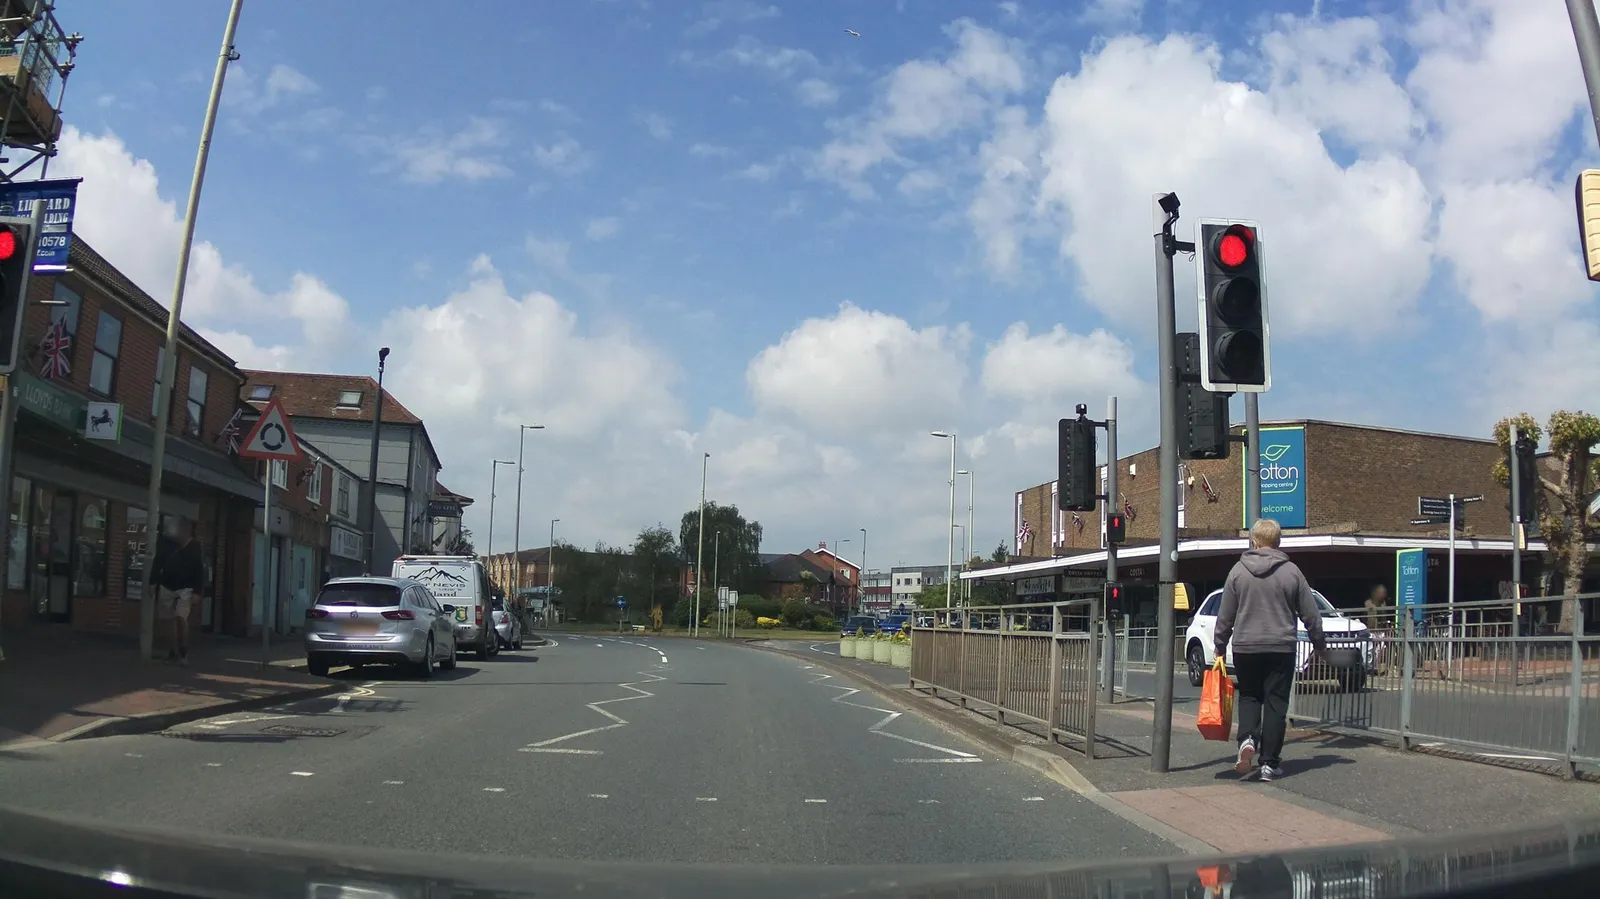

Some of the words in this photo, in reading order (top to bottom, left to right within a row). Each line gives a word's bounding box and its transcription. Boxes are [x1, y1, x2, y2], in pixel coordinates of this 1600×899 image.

[1260, 463, 1299, 480] otton
[1129, 567, 1143, 577] COSTA
[1402, 565, 1420, 576] Totton
